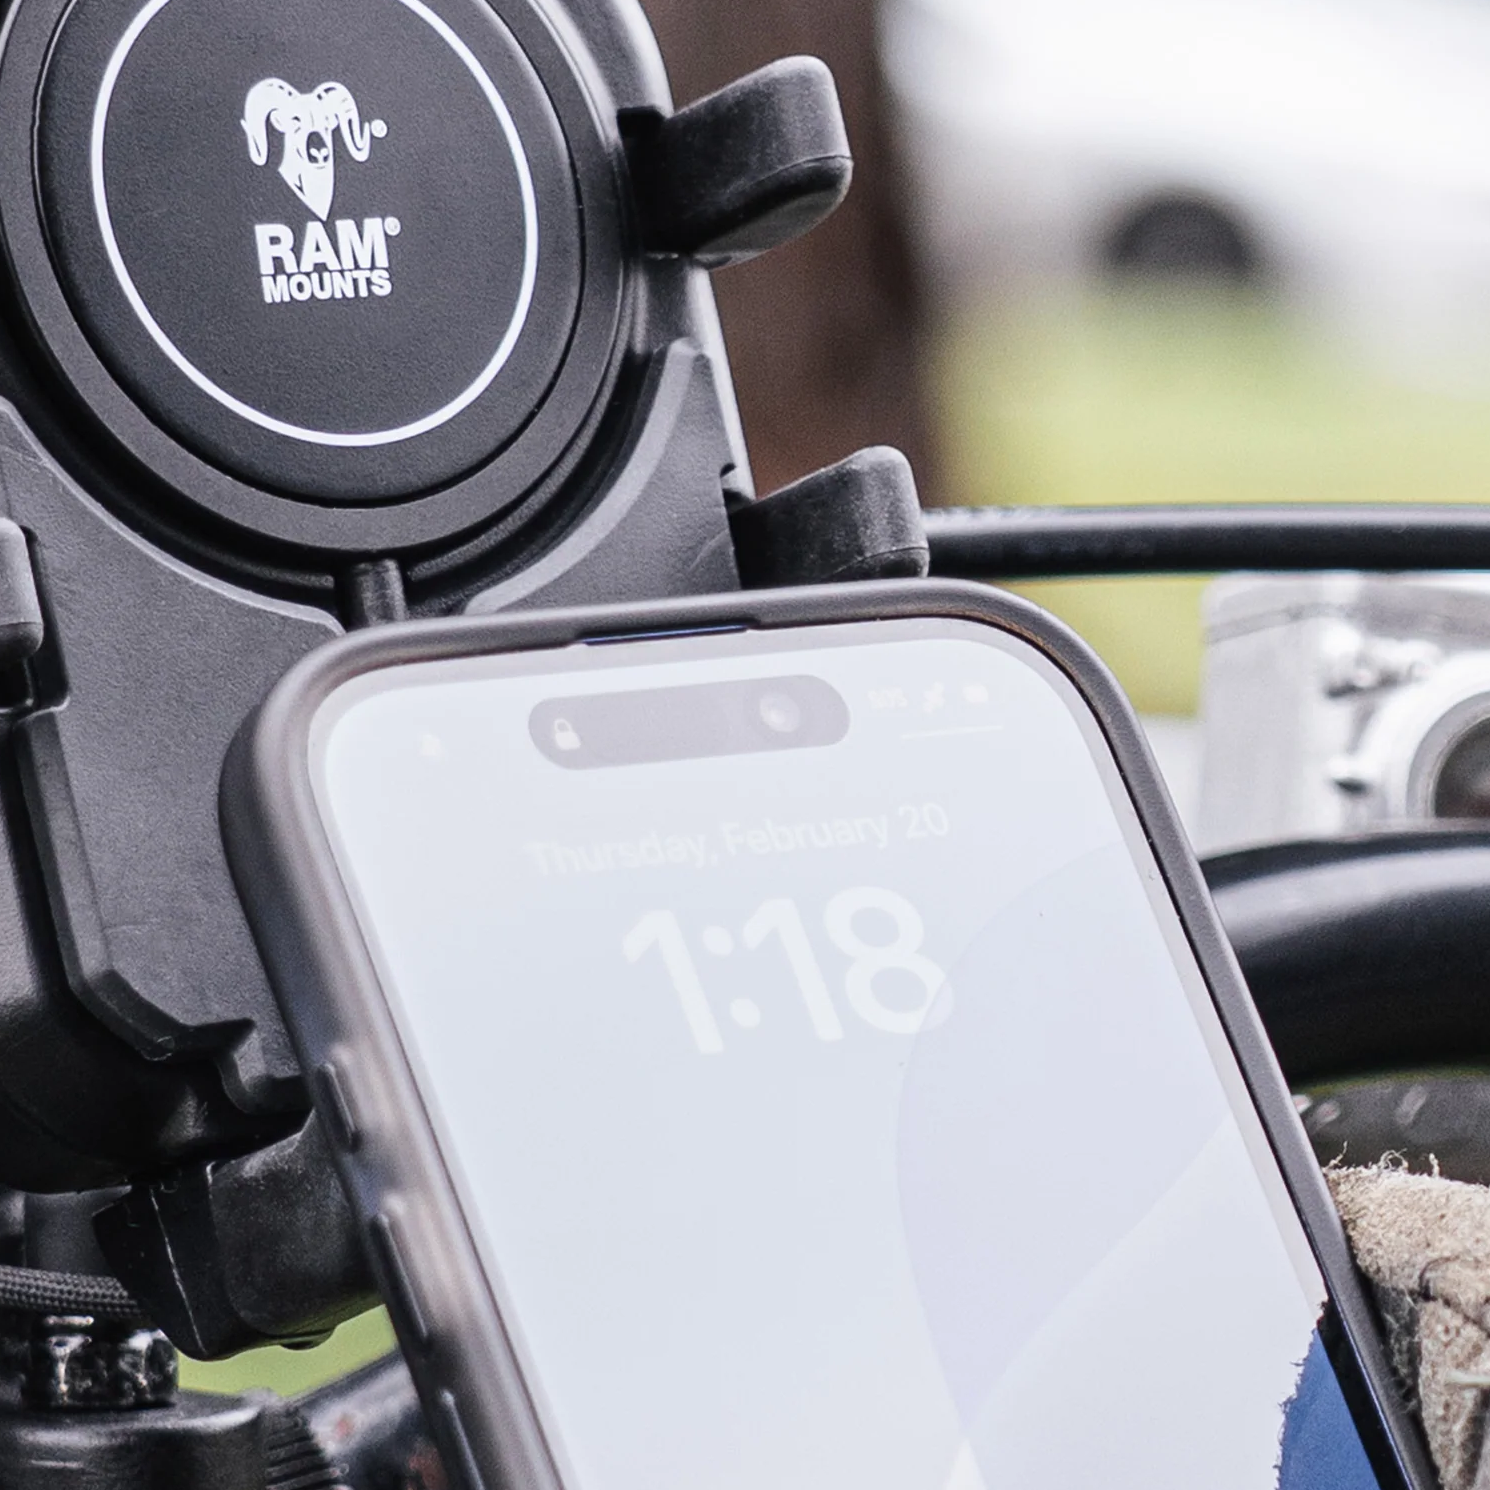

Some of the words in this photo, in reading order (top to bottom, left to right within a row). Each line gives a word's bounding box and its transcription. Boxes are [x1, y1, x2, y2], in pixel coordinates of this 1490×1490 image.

[260, 269, 393, 303] MOUNTS
[523, 830, 718, 876] Thursday,
[721, 813, 890, 857] February
[899, 802, 950, 839] 20
[622, 886, 955, 1054] 1:18
